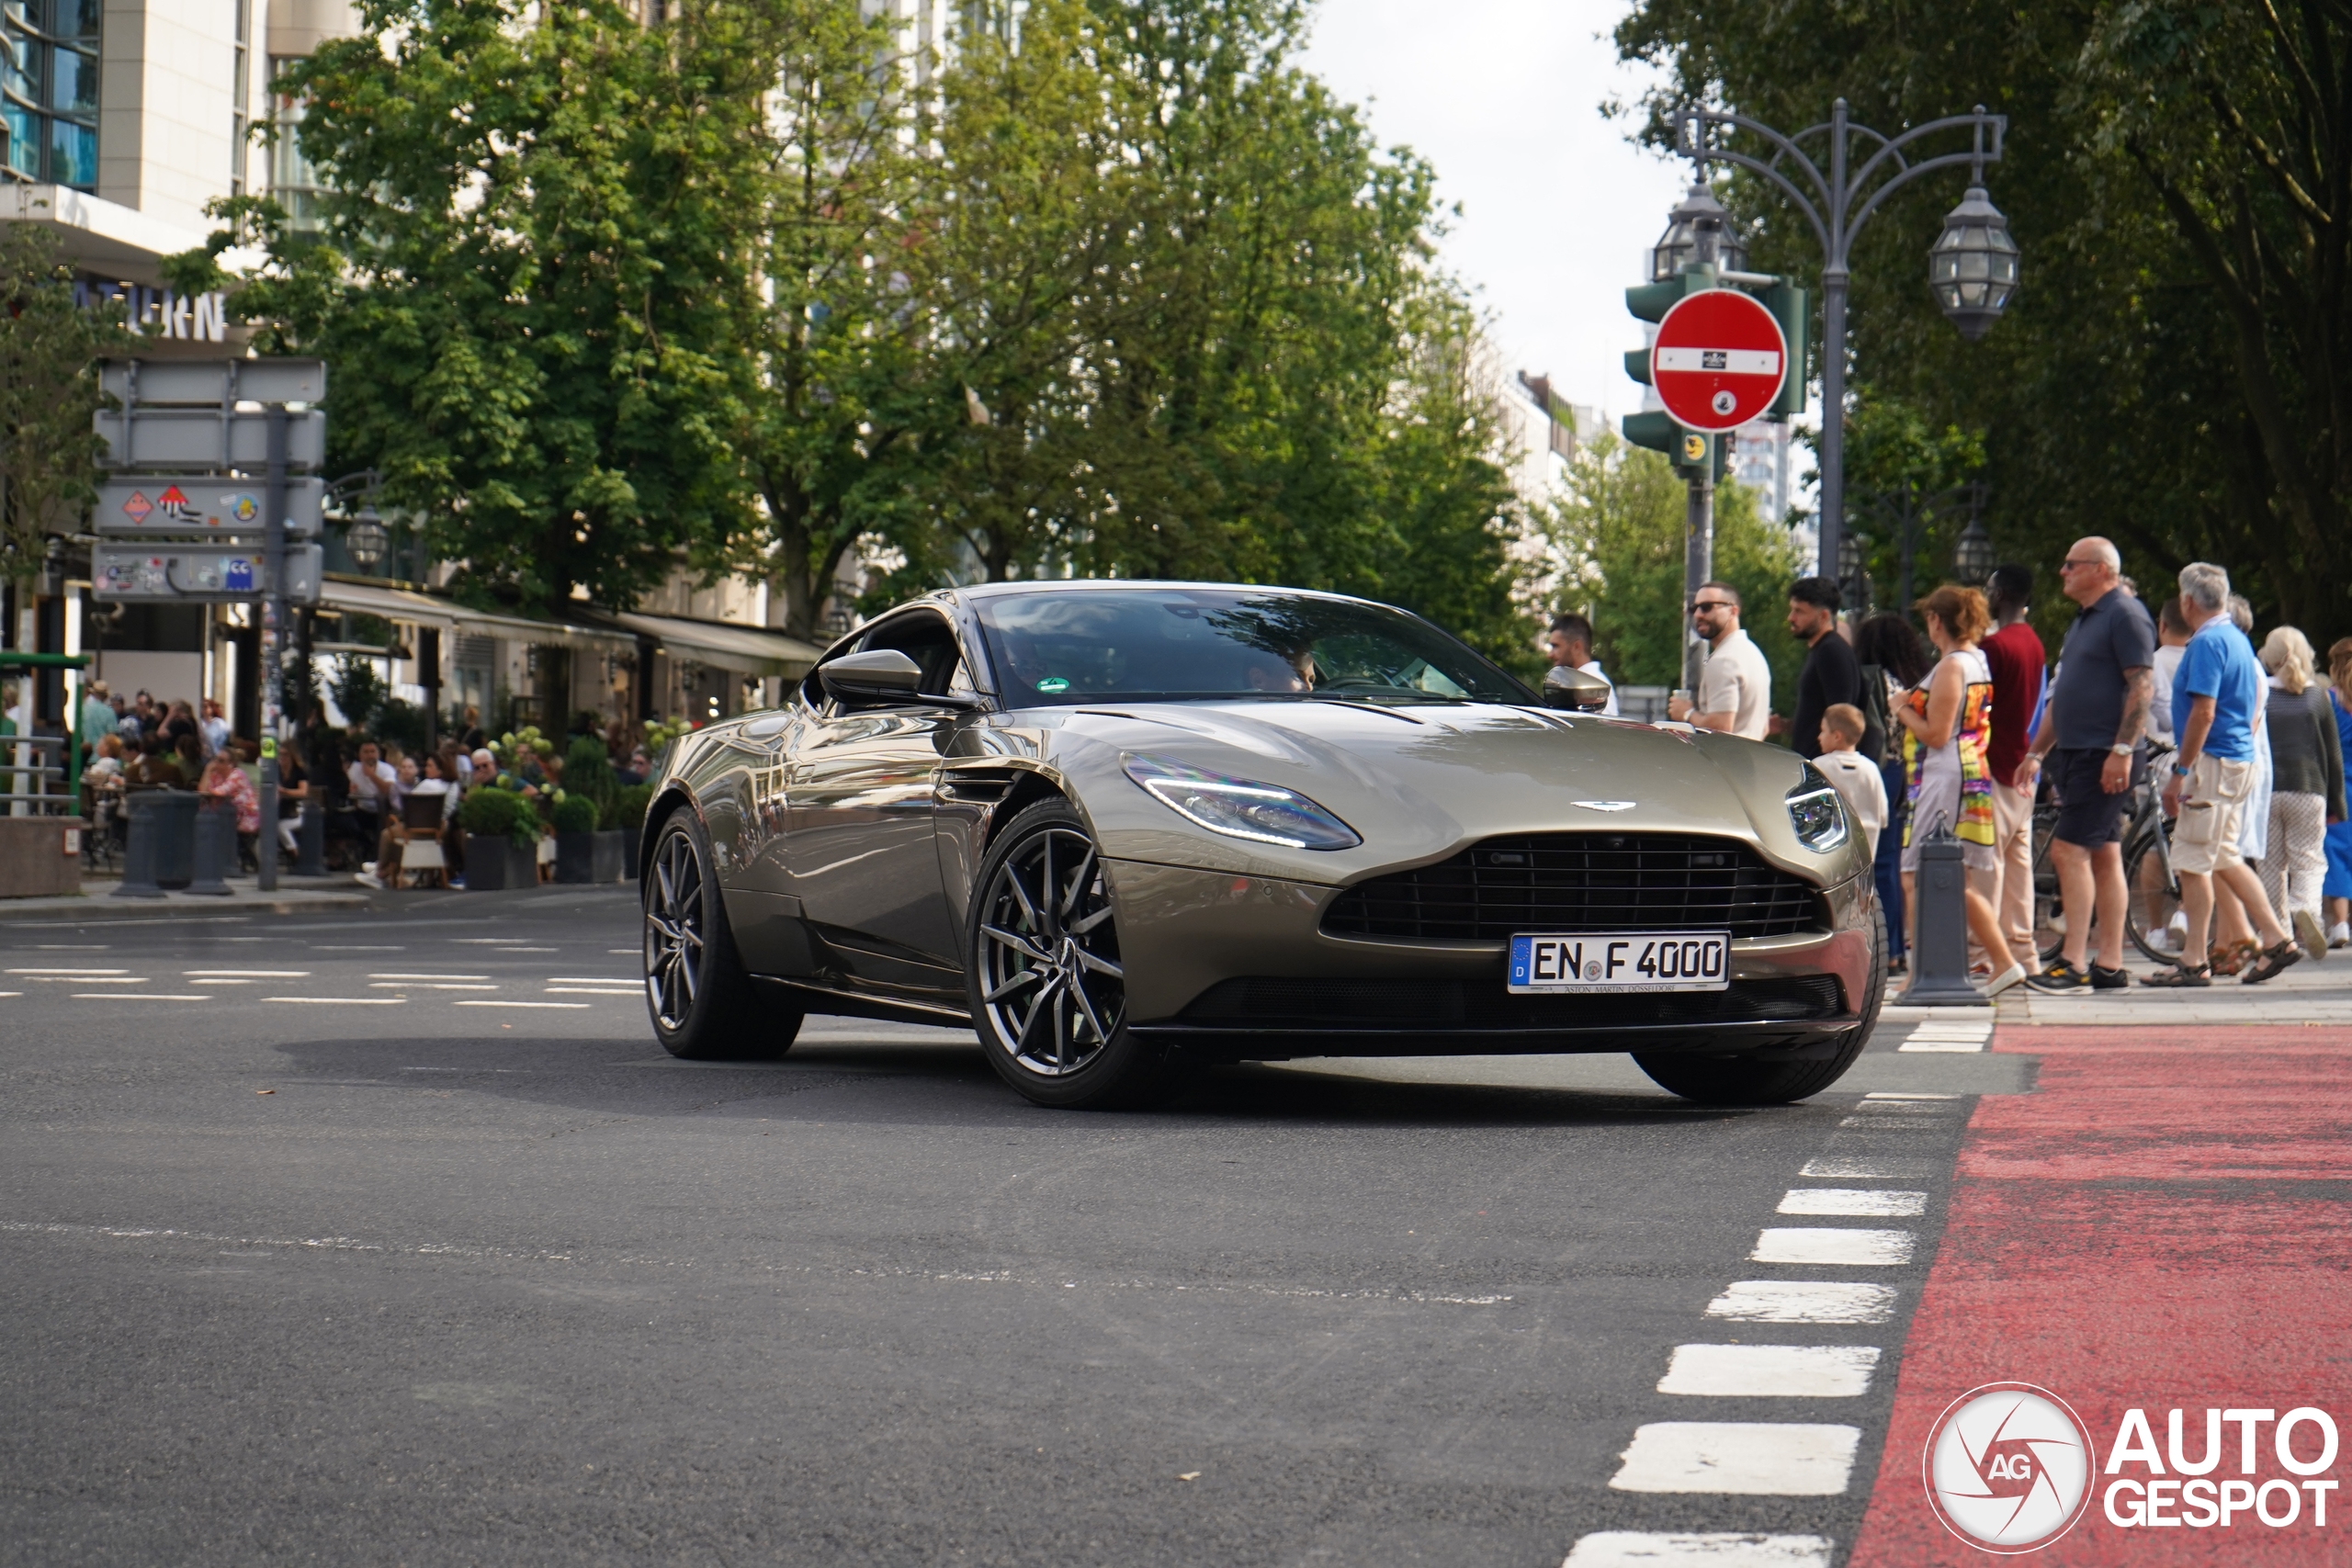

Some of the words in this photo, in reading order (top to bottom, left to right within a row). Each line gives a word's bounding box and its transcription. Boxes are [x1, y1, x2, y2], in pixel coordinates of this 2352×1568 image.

[1516, 966, 1524, 977] D
[1534, 942, 1582, 979] EN
[1607, 942, 1629, 979] F
[1637, 941, 1722, 978] 4000
